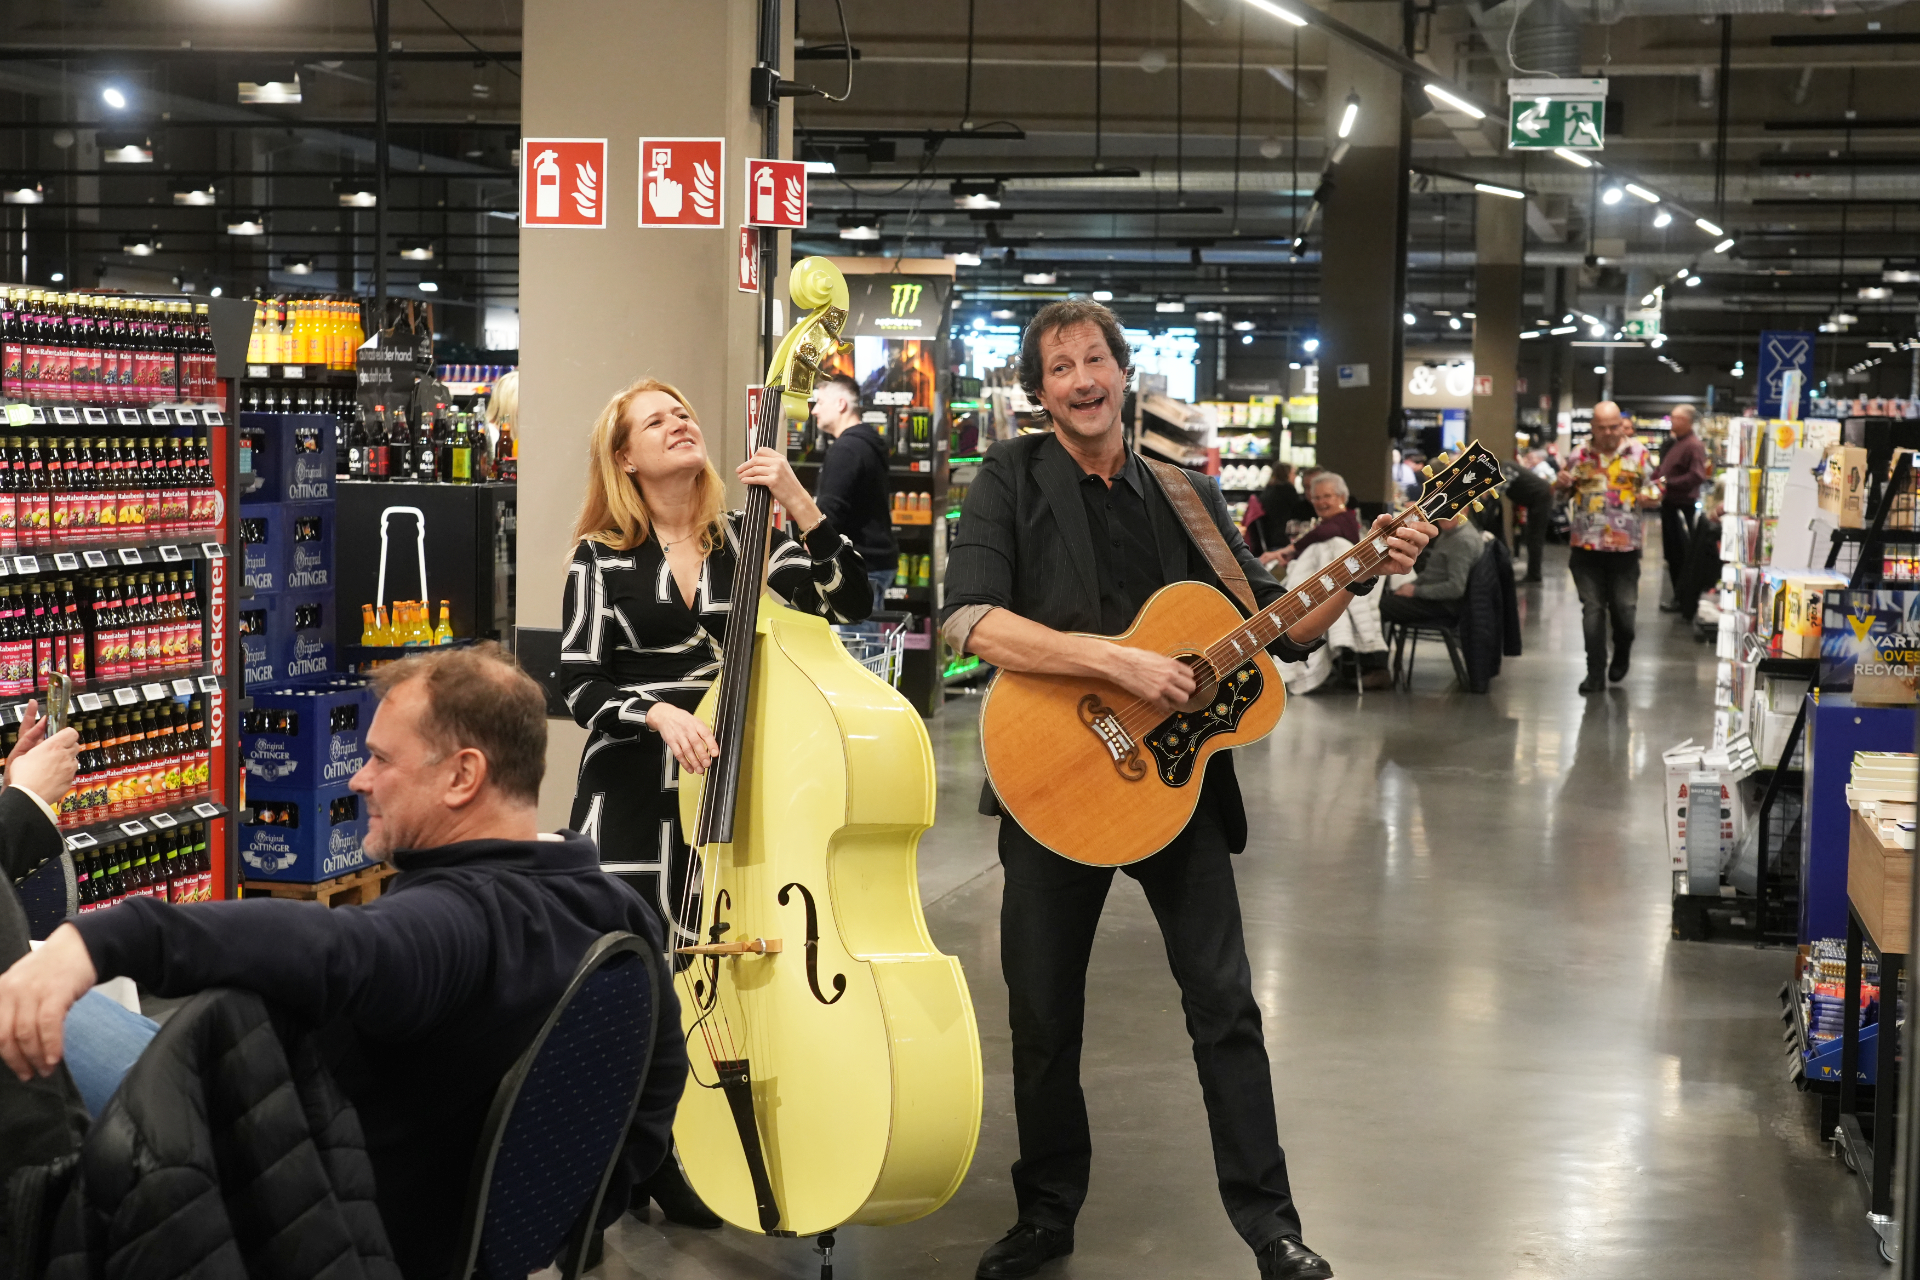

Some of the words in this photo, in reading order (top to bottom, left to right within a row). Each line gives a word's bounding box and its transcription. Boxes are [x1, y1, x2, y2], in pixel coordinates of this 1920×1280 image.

[1409, 366, 1437, 395] &
[9, 408, 28, 422] BIO
[1477, 453, 1497, 474] Gibson
[255, 738, 285, 752] Original
[329, 735, 358, 763] Original
[254, 829, 285, 844] Original
[1833, 1069, 1867, 1079] VTA
